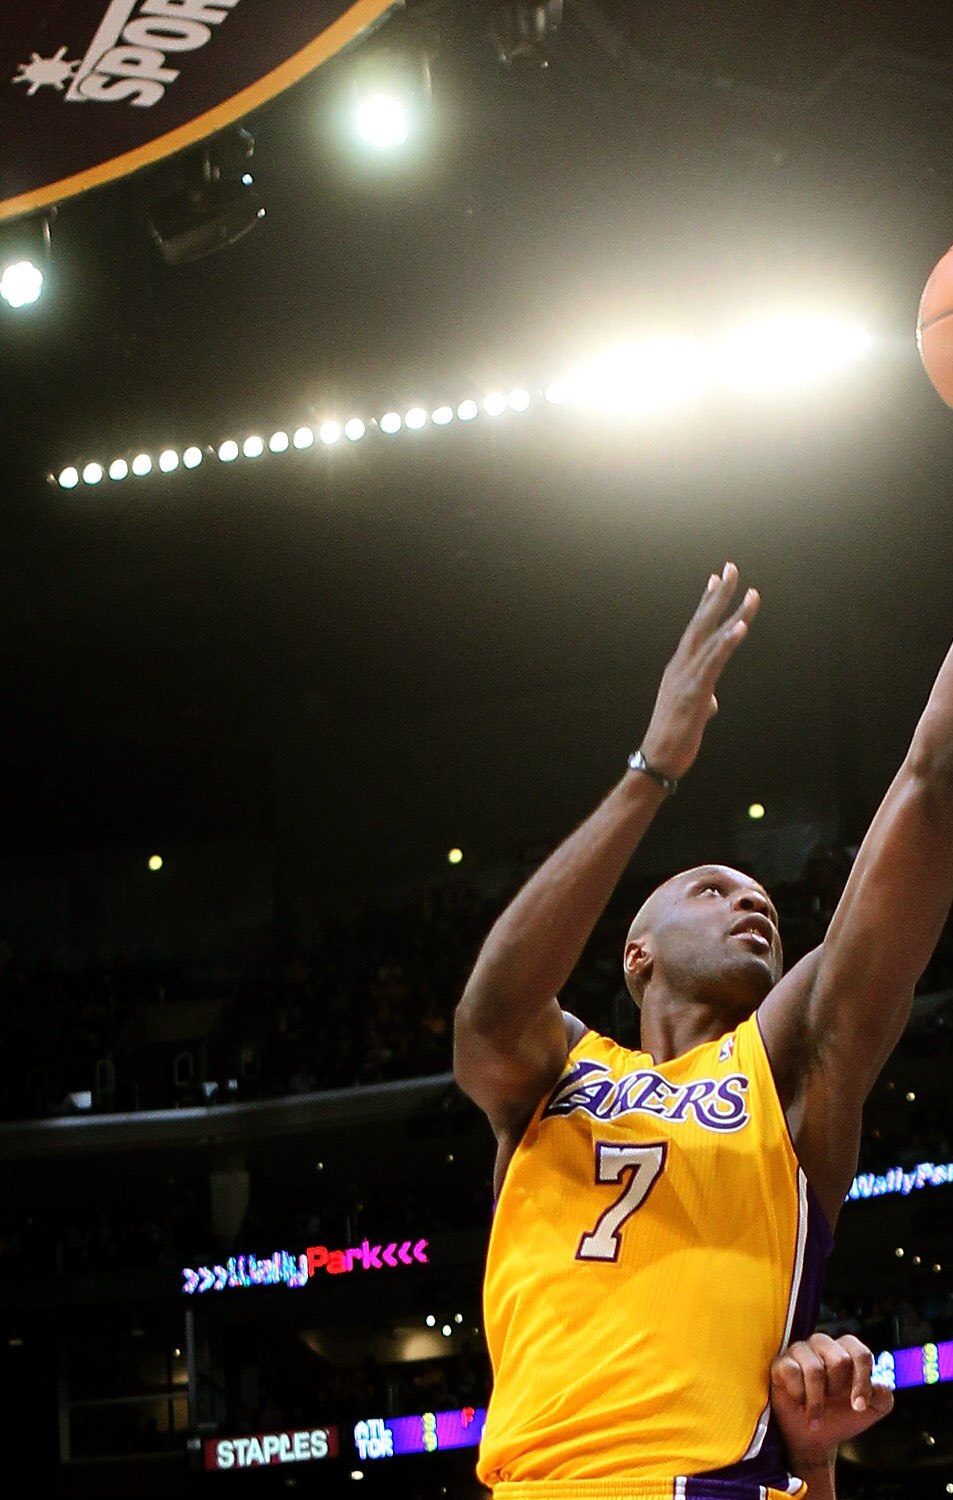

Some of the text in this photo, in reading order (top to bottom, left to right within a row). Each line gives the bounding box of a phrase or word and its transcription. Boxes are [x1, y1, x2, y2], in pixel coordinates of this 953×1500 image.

[542, 1061, 750, 1133] LAKERS
[575, 1140, 669, 1262] 7
[216, 1430, 329, 1469] STAPLES
[357, 1436, 394, 1460] TOR
